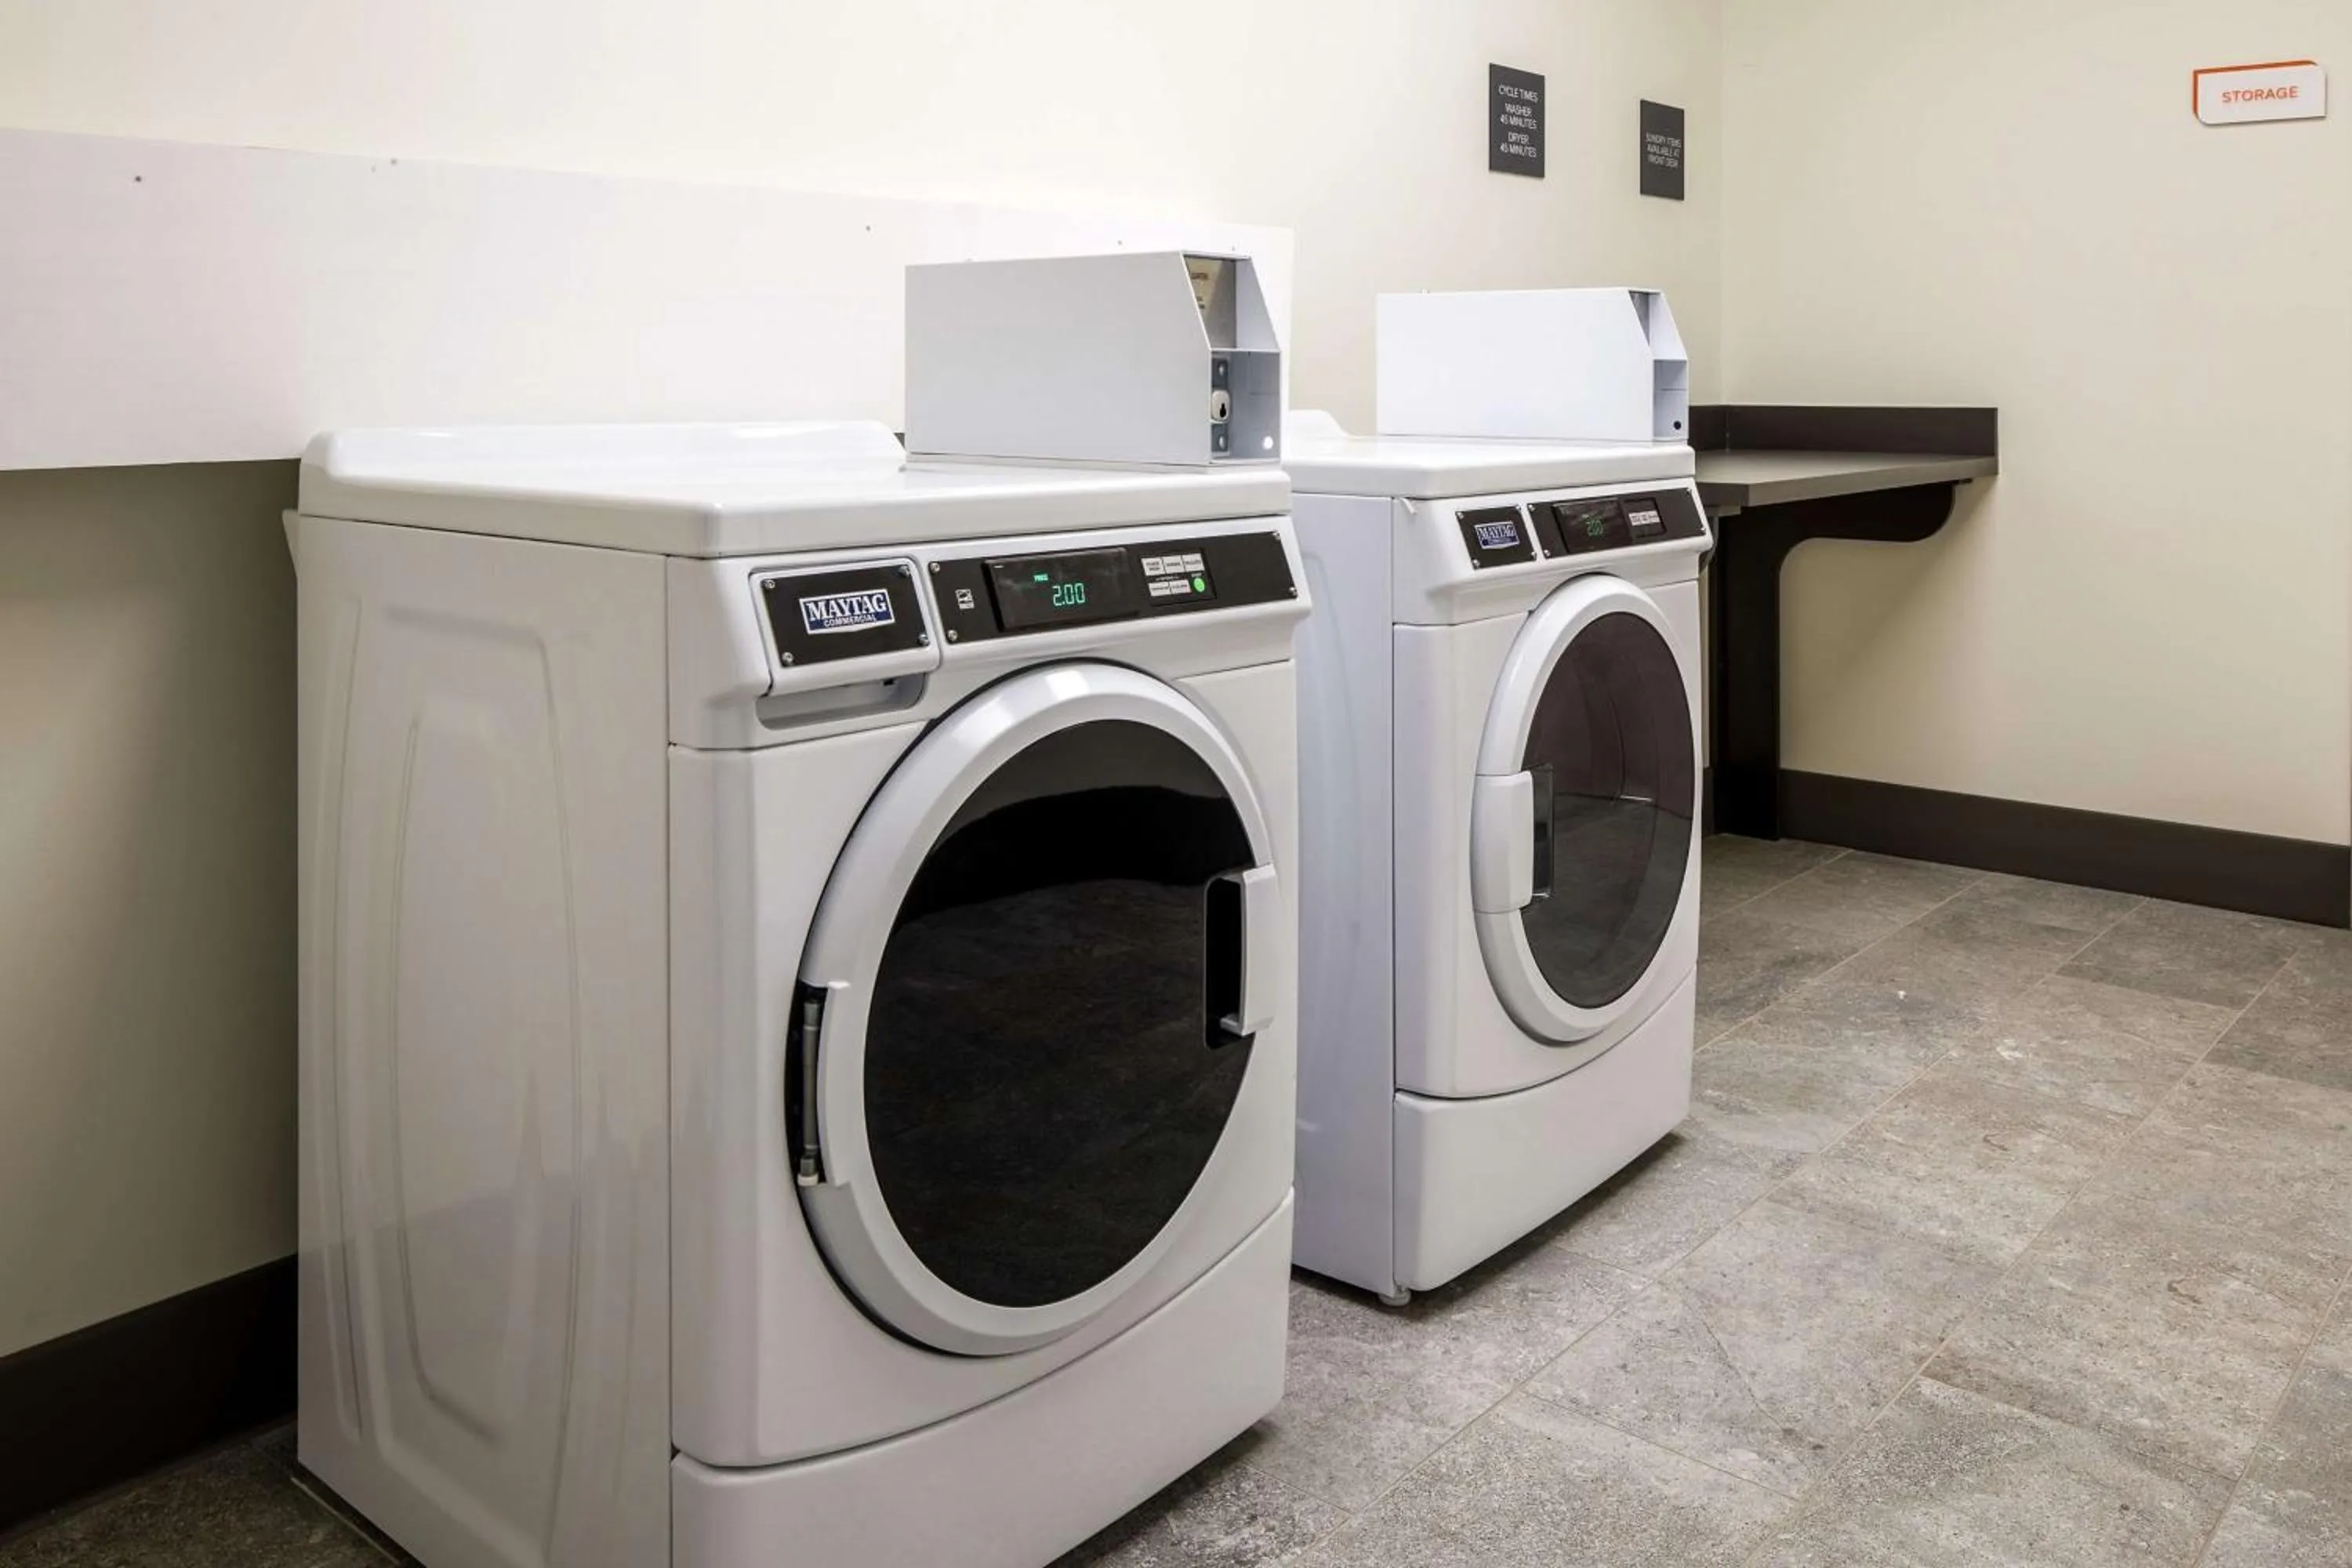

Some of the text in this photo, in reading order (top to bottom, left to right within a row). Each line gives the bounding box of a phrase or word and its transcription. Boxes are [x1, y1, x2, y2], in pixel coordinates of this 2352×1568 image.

[1498, 84, 1538, 102] CYCLE TIMES
[2222, 85, 2299, 103] STORAGE
[1500, 114, 1537, 129] 45 MINUTES
[1500, 142, 1537, 158] 45 MINUTES
[1478, 524, 1515, 541] MAYTAG
[1052, 583, 1085, 607] 2.00
[805, 593, 887, 622] MAYTAG
[823, 614, 877, 628] COMMERCIAL
